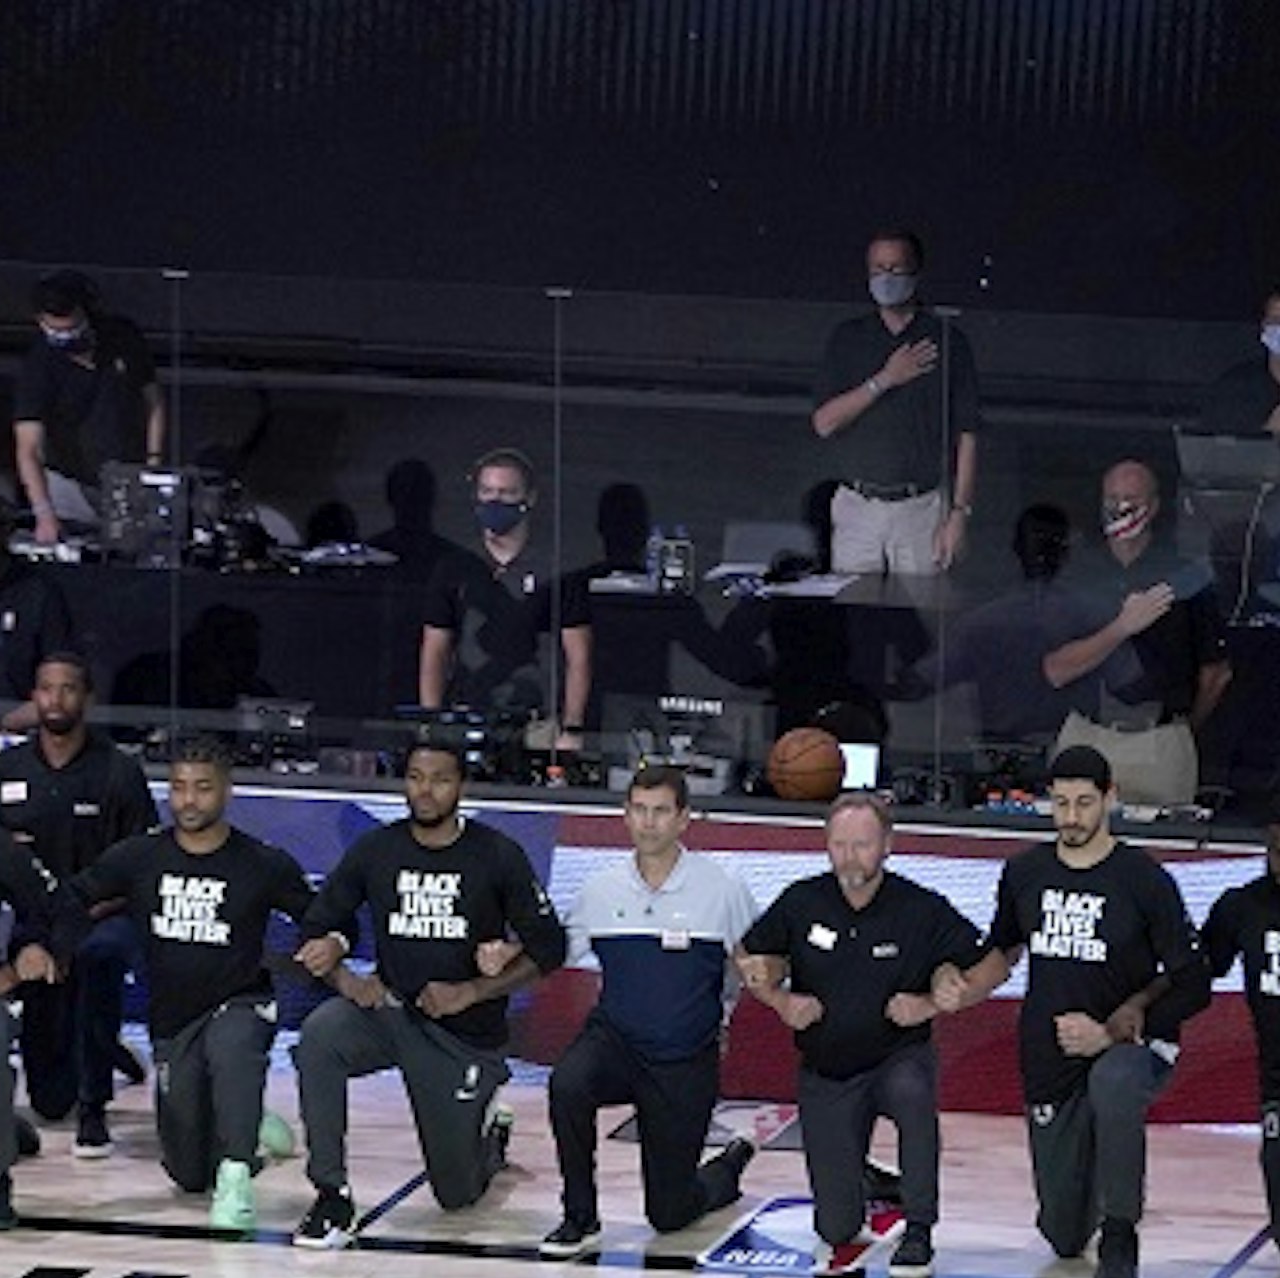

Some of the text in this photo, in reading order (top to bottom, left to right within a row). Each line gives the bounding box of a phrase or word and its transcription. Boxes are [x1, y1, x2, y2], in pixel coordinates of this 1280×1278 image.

[158, 873, 227, 905] BLACK
[396, 870, 461, 899] BLACK
[162, 896, 219, 922] LIVES
[402, 892, 454, 917] LIVES
[1041, 889, 1107, 919] BLACK
[151, 913, 231, 945] MATTER
[388, 912, 469, 939] MATTER
[1045, 911, 1095, 939] LIVES
[1030, 931, 1107, 962] MATTER
